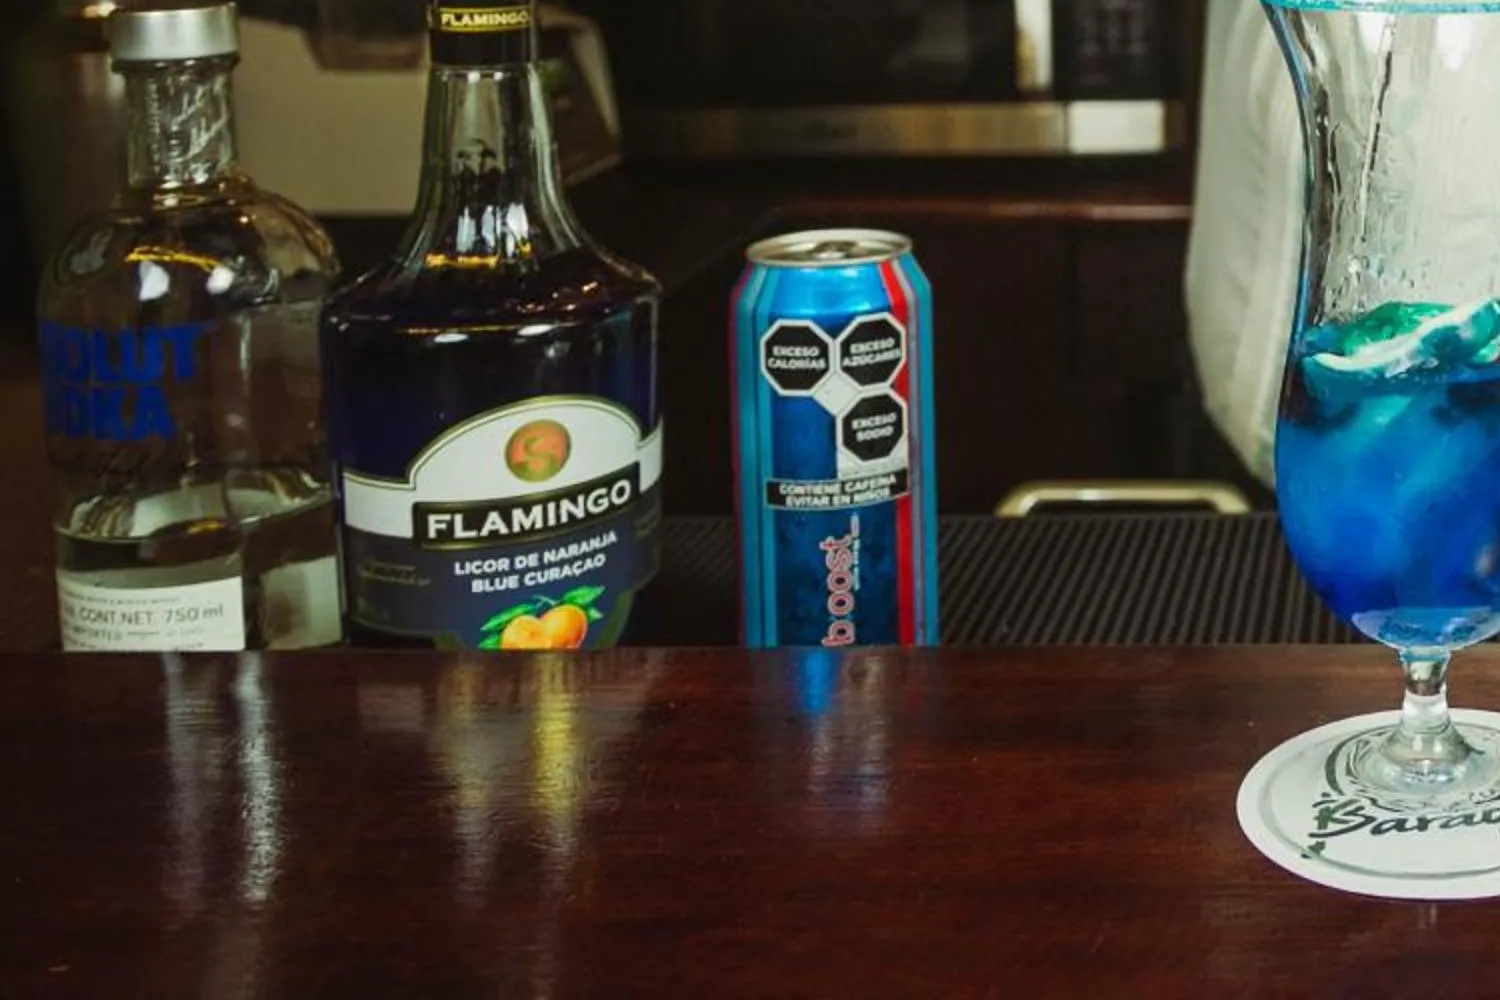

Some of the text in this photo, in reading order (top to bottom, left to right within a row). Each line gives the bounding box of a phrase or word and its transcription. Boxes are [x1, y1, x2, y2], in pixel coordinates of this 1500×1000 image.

[441, 10, 529, 27] FLAMINGO
[772, 346, 820, 357] EXCESO
[850, 337, 895, 354] EXCESO
[851, 412, 897, 430] EXCESO
[856, 426, 894, 442] SODIO
[779, 482, 841, 495] CONTIENE
[427, 478, 632, 540] FLAMINGO
[785, 495, 830, 507] EVITAR
[831, 495, 851, 506] EN
[454, 555, 511, 576] LICOR
[514, 552, 540, 570] DE
[543, 529, 618, 564] NARANJA
[471, 553, 607, 593] BLUE CURAÇAO
[164, 607, 200, 623] 750
[203, 603, 223, 619] ml
